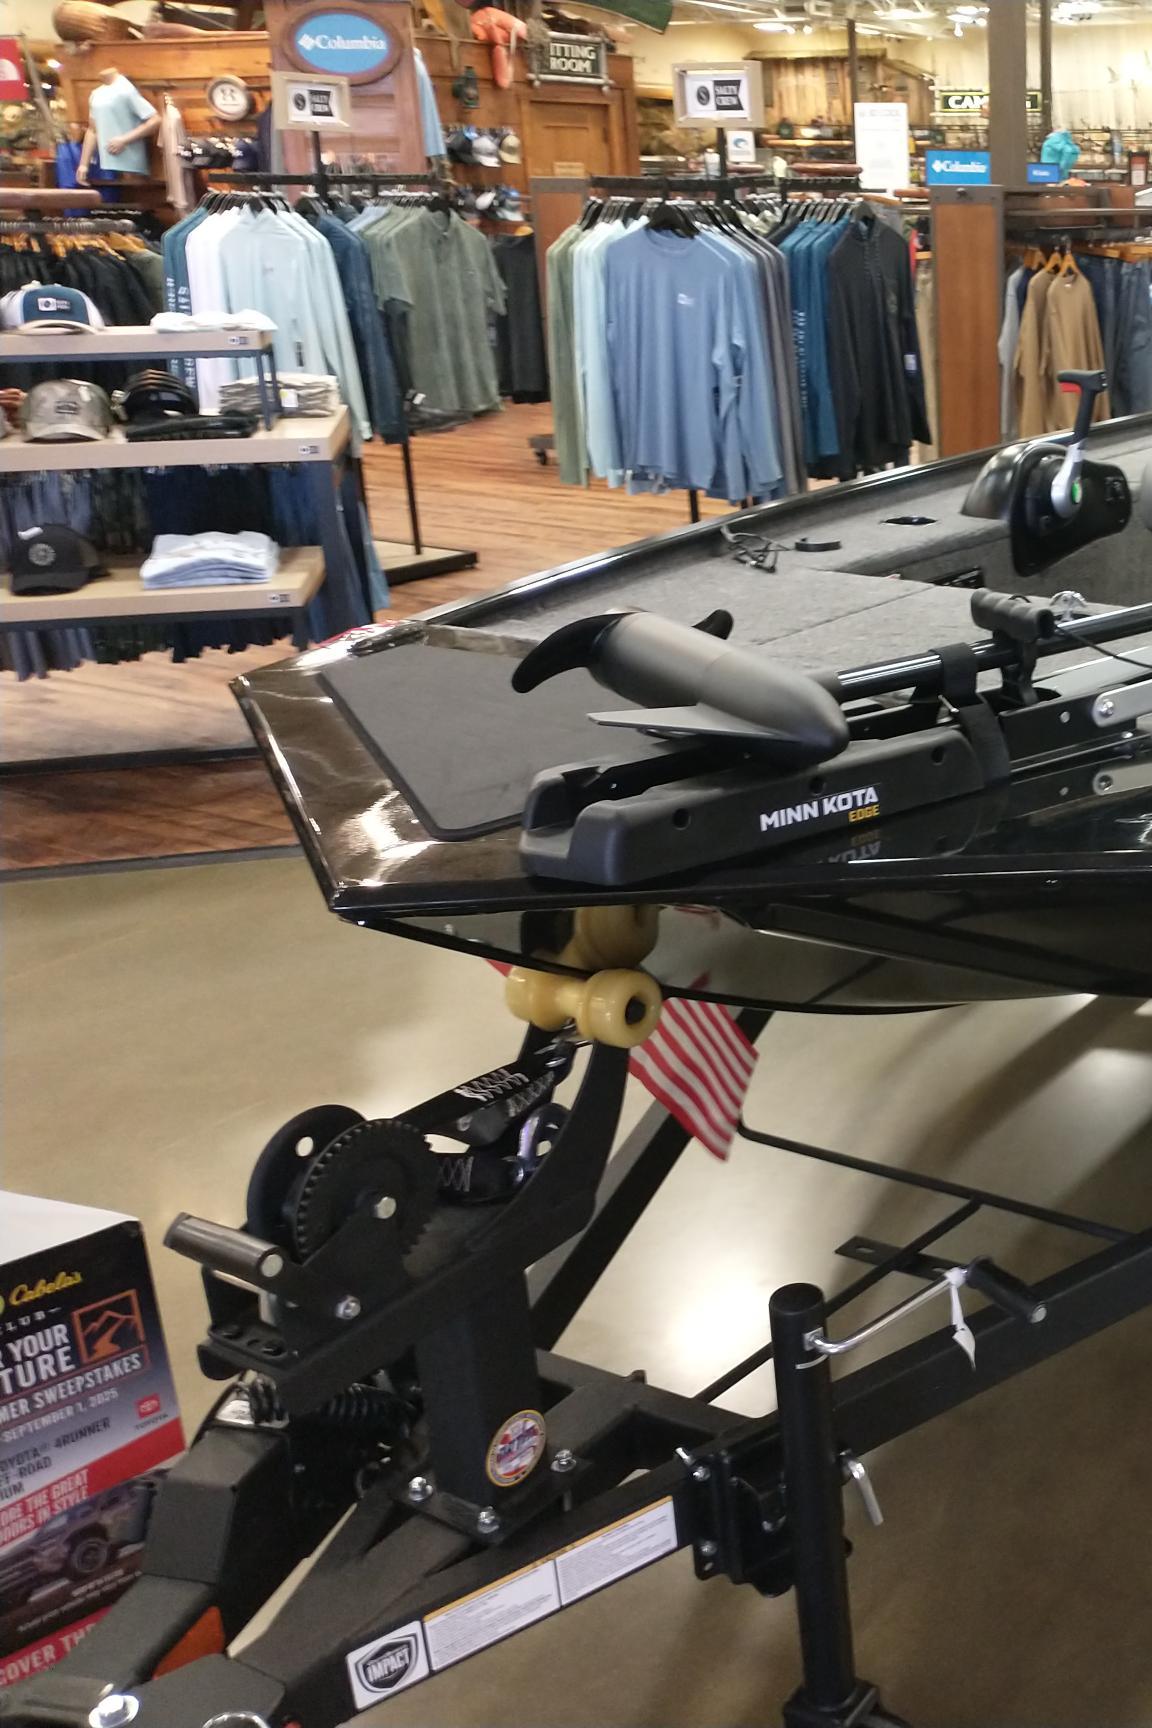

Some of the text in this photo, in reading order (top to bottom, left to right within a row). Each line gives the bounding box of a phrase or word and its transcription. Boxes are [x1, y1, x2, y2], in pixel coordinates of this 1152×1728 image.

[315, 34, 387, 50] Columbia
[549, 43, 596, 60] ITTING
[550, 57, 592, 73] ROOM
[760, 786, 879, 832] MINN KOTA
[848, 804, 880, 823] EDGE
[9, 1271, 83, 1305] Cabela's
[6, 1324, 70, 1362] YOUR
[32, 1353, 141, 1409] SWEEPSTAKES
[2, 1404, 74, 1442] SEPTEMBER
[54, 1417, 111, 1448] 4RUNNER
[366, 1646, 410, 1684] IMPACT
